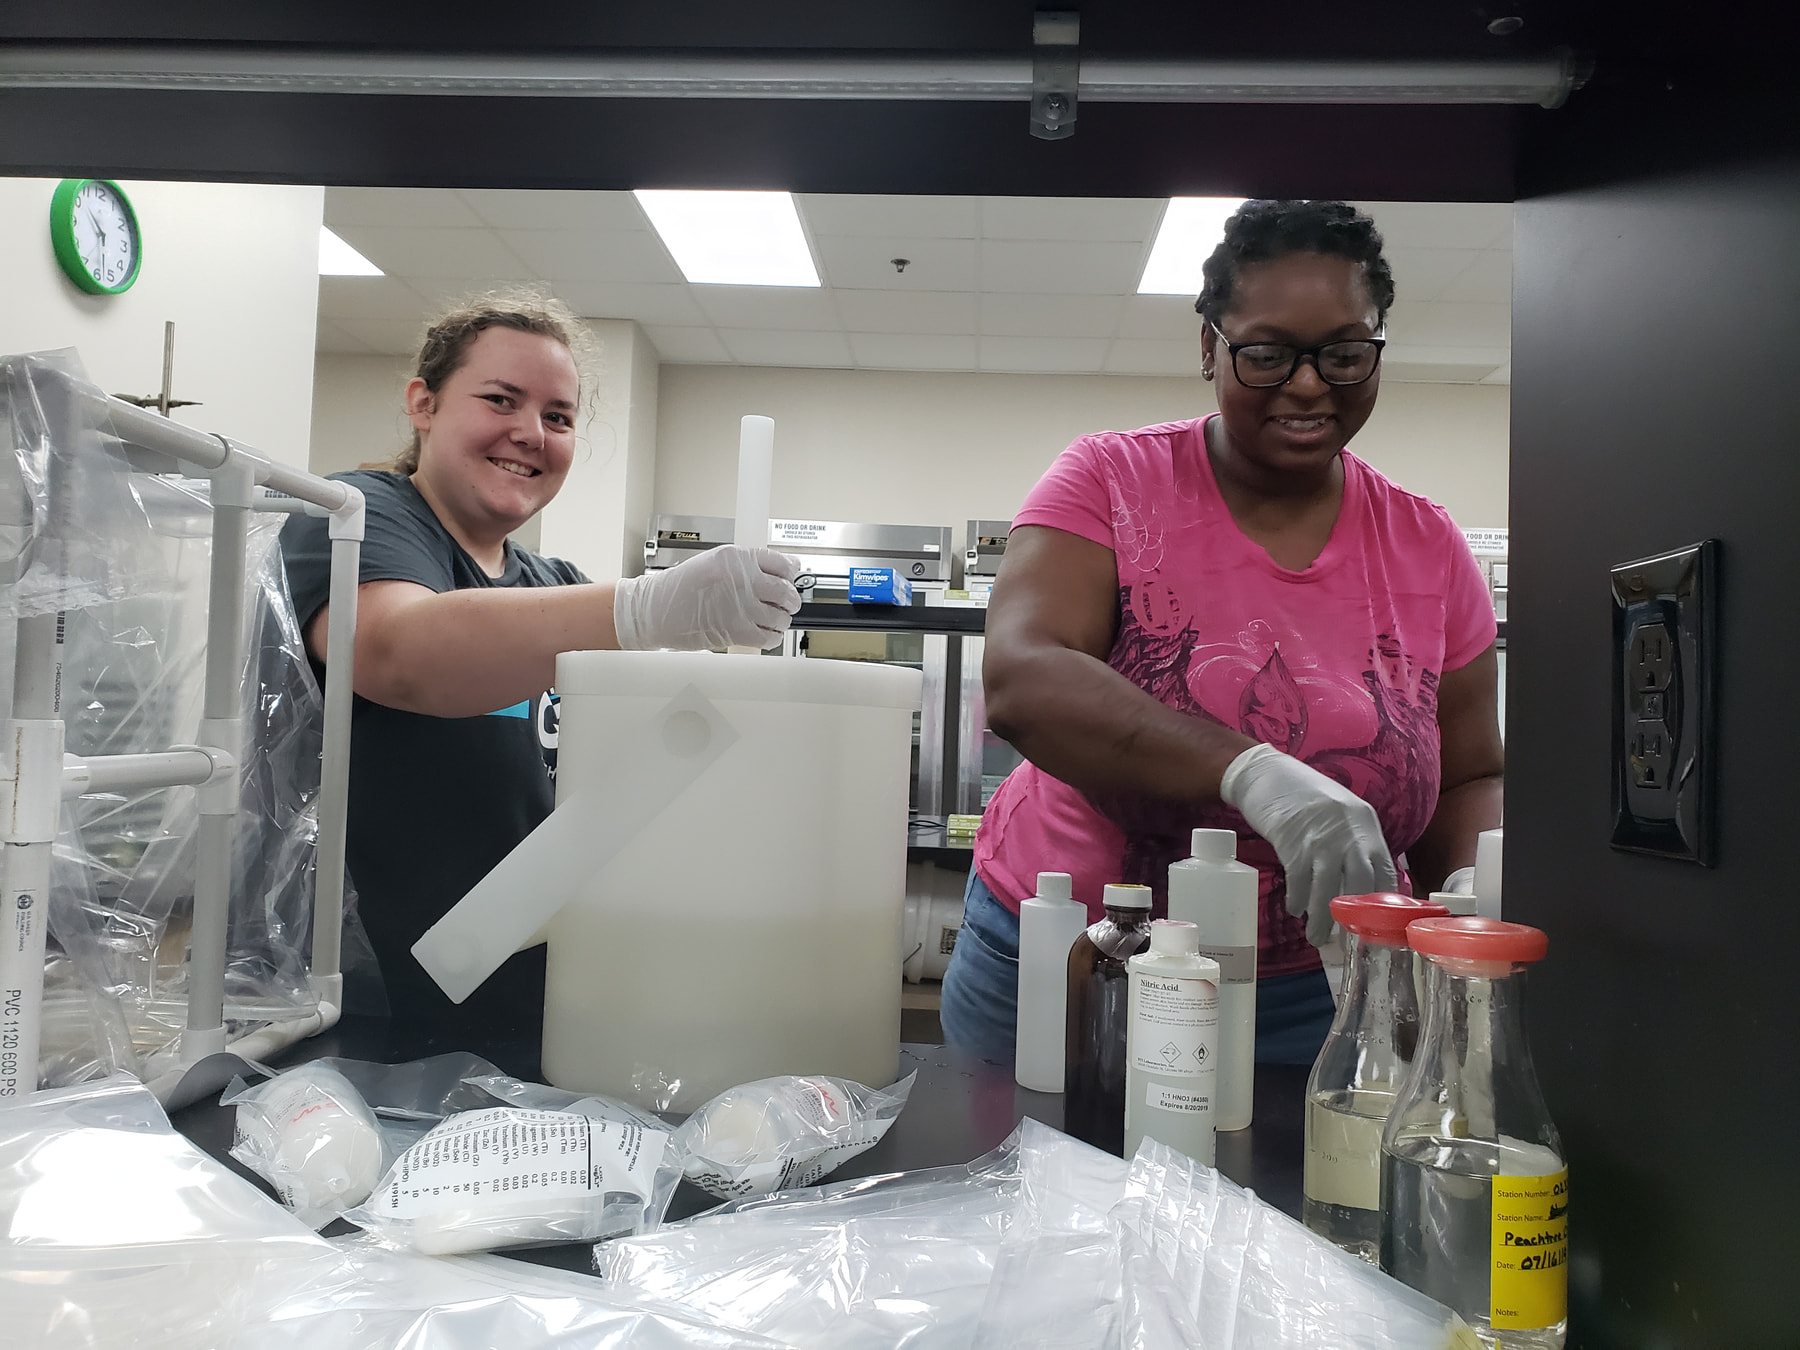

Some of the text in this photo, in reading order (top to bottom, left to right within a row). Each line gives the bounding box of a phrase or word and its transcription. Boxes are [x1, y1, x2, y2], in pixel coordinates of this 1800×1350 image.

[83, 186, 90, 198] 11
[95, 186, 106, 202] 12
[117, 217, 125, 232] 2
[120, 240, 128, 253] 3
[116, 259, 124, 272] 4
[93, 268, 101, 281] 6
[106, 269, 115, 282] 5
[854, 573, 890, 582] Kimwipes
[1141, 979, 1160, 990] Nitric
[4, 989, 21, 1016] PVC
[3, 1021, 19, 1049] 1120
[1, 1052, 17, 1075] 600
[1172, 1094, 1190, 1102] HNO3
[1160, 1100, 1183, 1110] Expires
[521, 1143, 529, 1154] (U)
[442, 1153, 450, 1161] (F)
[433, 1187, 440, 1195] 10
[453, 1185, 460, 1193] 10
[463, 1183, 470, 1191] 50
[412, 1190, 419, 1198] 10
[1497, 1190, 1523, 1198] Station
[1497, 1213, 1523, 1222] Station
[1505, 1231, 1561, 1246] Peachtree
[1496, 1261, 1516, 1269] Date:
[1496, 1308, 1519, 1317] Notes:
